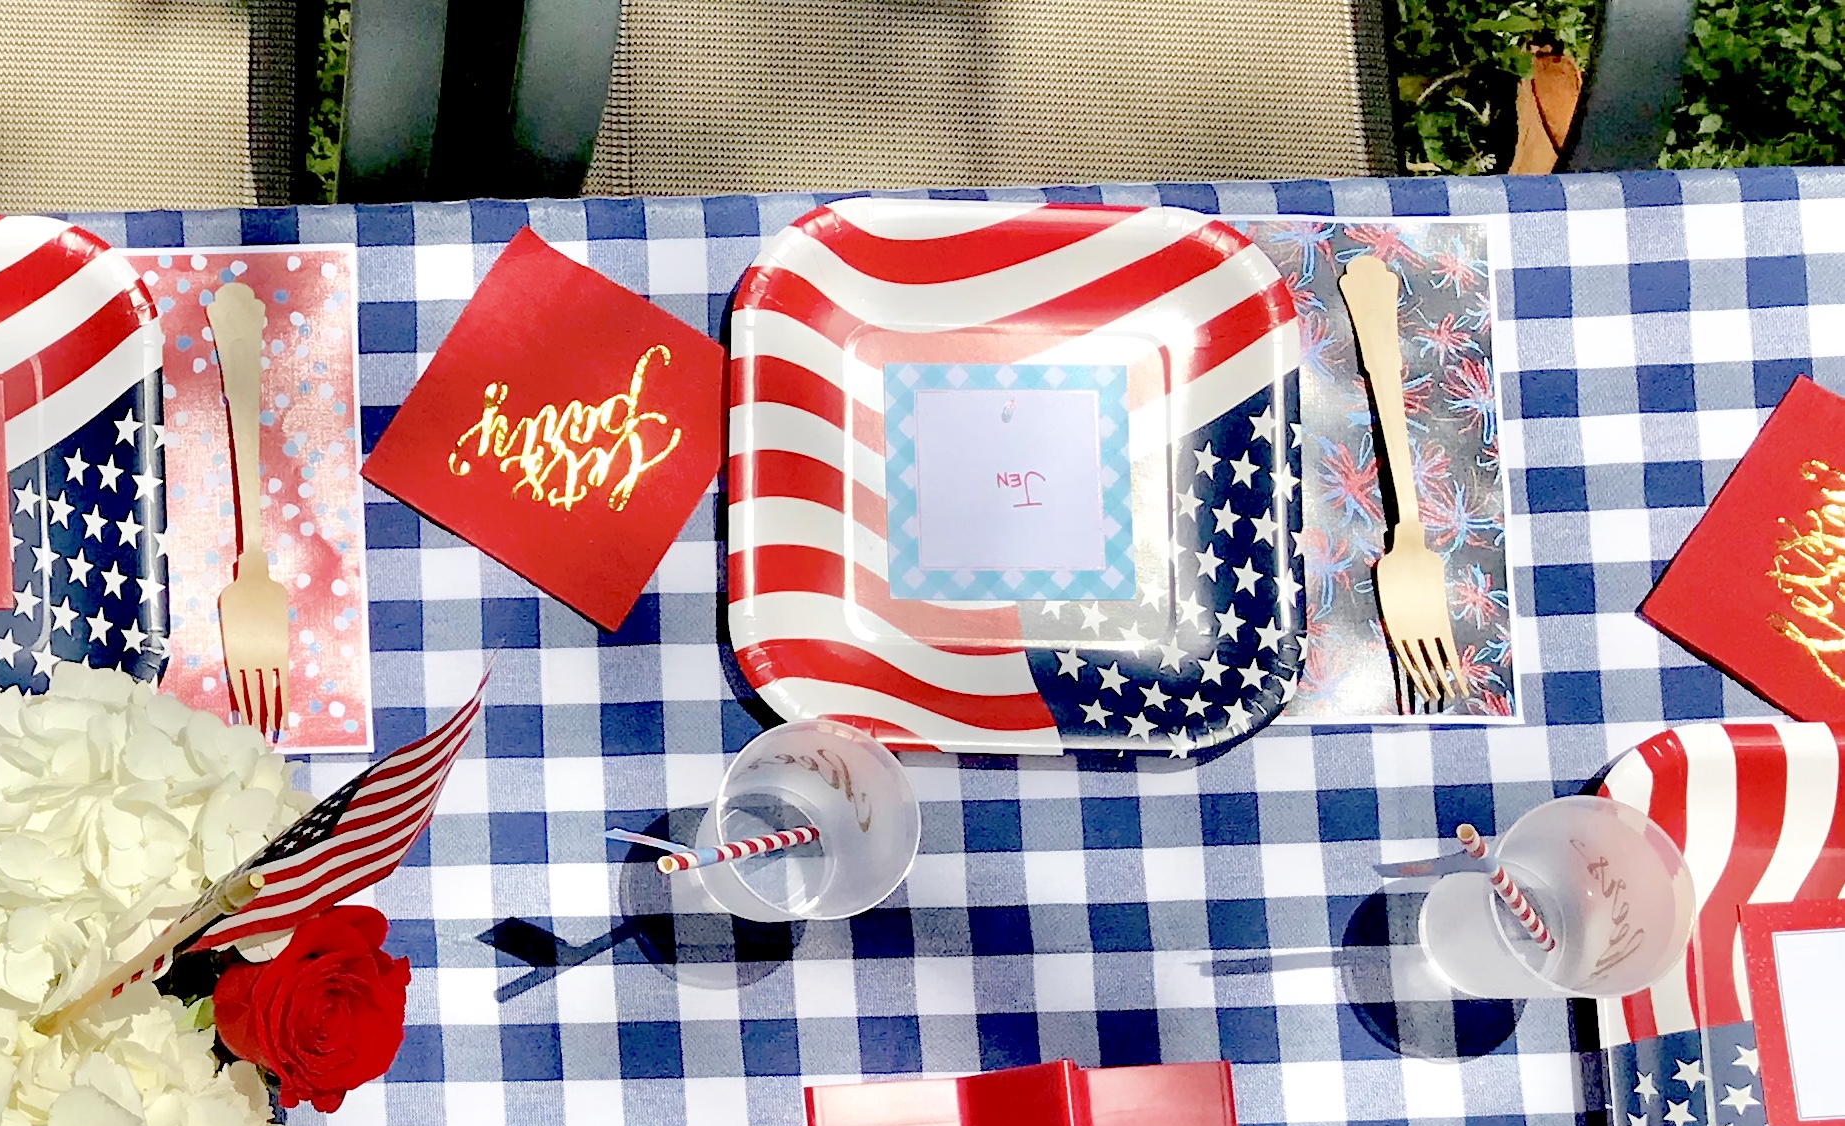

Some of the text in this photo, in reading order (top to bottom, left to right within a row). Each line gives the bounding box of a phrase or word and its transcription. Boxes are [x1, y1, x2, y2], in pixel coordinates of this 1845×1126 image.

[448, 344, 671, 476] party
[511, 428, 681, 512] let's
[996, 470, 1046, 508] JEN
